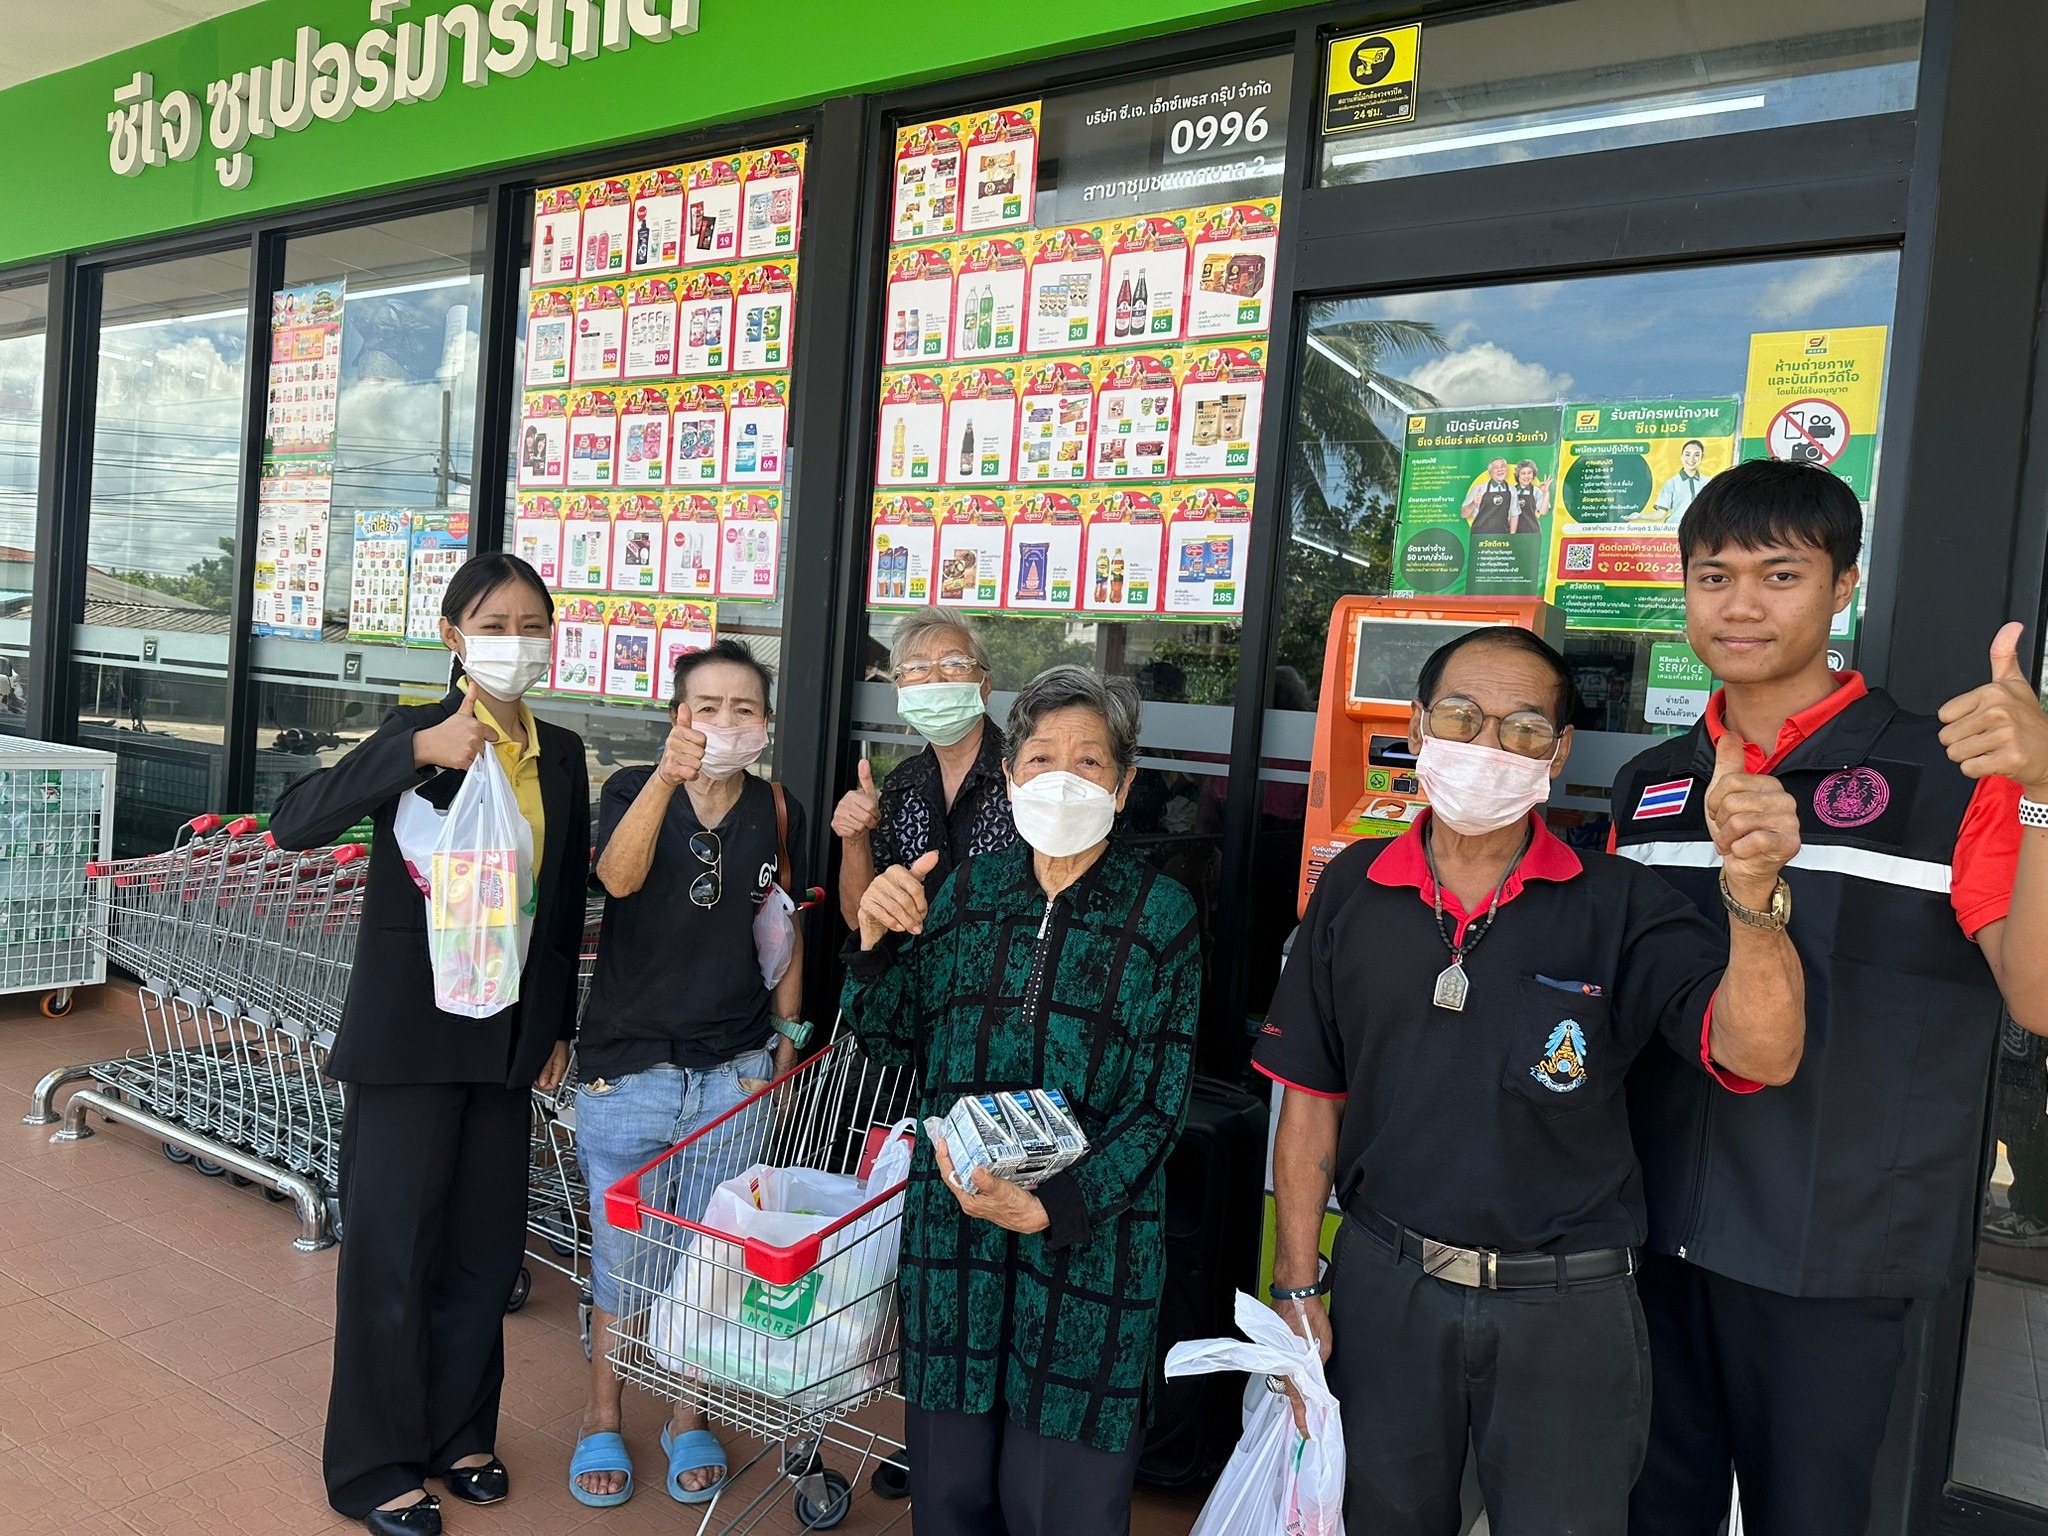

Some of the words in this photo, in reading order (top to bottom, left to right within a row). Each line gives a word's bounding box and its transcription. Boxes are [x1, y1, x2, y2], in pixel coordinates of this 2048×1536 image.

[1086, 107, 1117, 126] บริษัท
[1119, 104, 1146, 120] ซี.เจ.
[1150, 93, 1209, 114] เอ็กซ์เพรส
[1210, 86, 1236, 107] กรุ๊ป
[1238, 79, 1272, 98] จำกัด
[1353, 108, 1366, 120] 24
[1366, 107, 1383, 118] ชม.
[107, 71, 202, 177] ซีเจ
[1170, 106, 1270, 155] 0996
[1253, 155, 1266, 176] 2
[1005, 205, 1017, 215] 45
[720, 237, 729, 245] 19
[776, 235, 788, 244] 129
[560, 259, 572, 267] 127
[611, 258, 619, 266] 27
[1239, 310, 1254, 321] 48
[1153, 319, 1167, 330] 65
[1071, 327, 1083, 338] 30
[997, 335, 1009, 345] 25
[926, 342, 937, 352] 20
[603, 353, 615, 362] 199
[655, 354, 668, 362] 109
[709, 355, 718, 363] 69
[767, 351, 776, 359] 45
[1775, 358, 1855, 372] ห้ามถ่ายภาพ
[1768, 370, 1860, 386] และบันทึกวีดีโอ
[1776, 386, 1848, 396] โดยไม่ได้รับอนุญาต
[1610, 407, 1719, 421] รับสมัครพนักงาน
[1447, 417, 1520, 433] เปิดรับสมัคร
[1635, 423, 1657, 434] ซีเจ
[1660, 420, 1687, 433] มอร์
[1417, 436, 1433, 447] ซีเจ
[1434, 434, 1463, 446] ซีเนียร์
[1465, 435, 1486, 444] พลัส
[1488, 434, 1504, 444] (60
[1506, 432, 1513, 443] ปี
[1515, 429, 1549, 443] วัยเก๋า)
[1574, 444, 1644, 455] พนักงานปฏิบัติการ
[1226, 453, 1245, 464] 106
[763, 460, 773, 468] 69
[983, 463, 995, 473] 29
[702, 467, 712, 475] 39
[913, 465, 924, 474] 44
[1408, 543, 1446, 552] อัตราค่าจ้าง
[1478, 540, 1509, 548] สวัสดิการ
[1418, 552, 1454, 562] บาท/ชั่วโมง
[754, 573, 768, 582] 119
[910, 582, 924, 591] 110
[980, 588, 991, 597] 12
[1052, 591, 1067, 600] 149
[1130, 591, 1143, 601] 15
[1213, 592, 1232, 602] 185
[1659, 655, 1680, 663] KBank
[1658, 663, 1703, 674] SERVICE
[1666, 695, 1689, 704] จ่ายบิล
[1654, 706, 1698, 718] ยืนยันตัวตน
[747, 1311, 793, 1334] MORE
